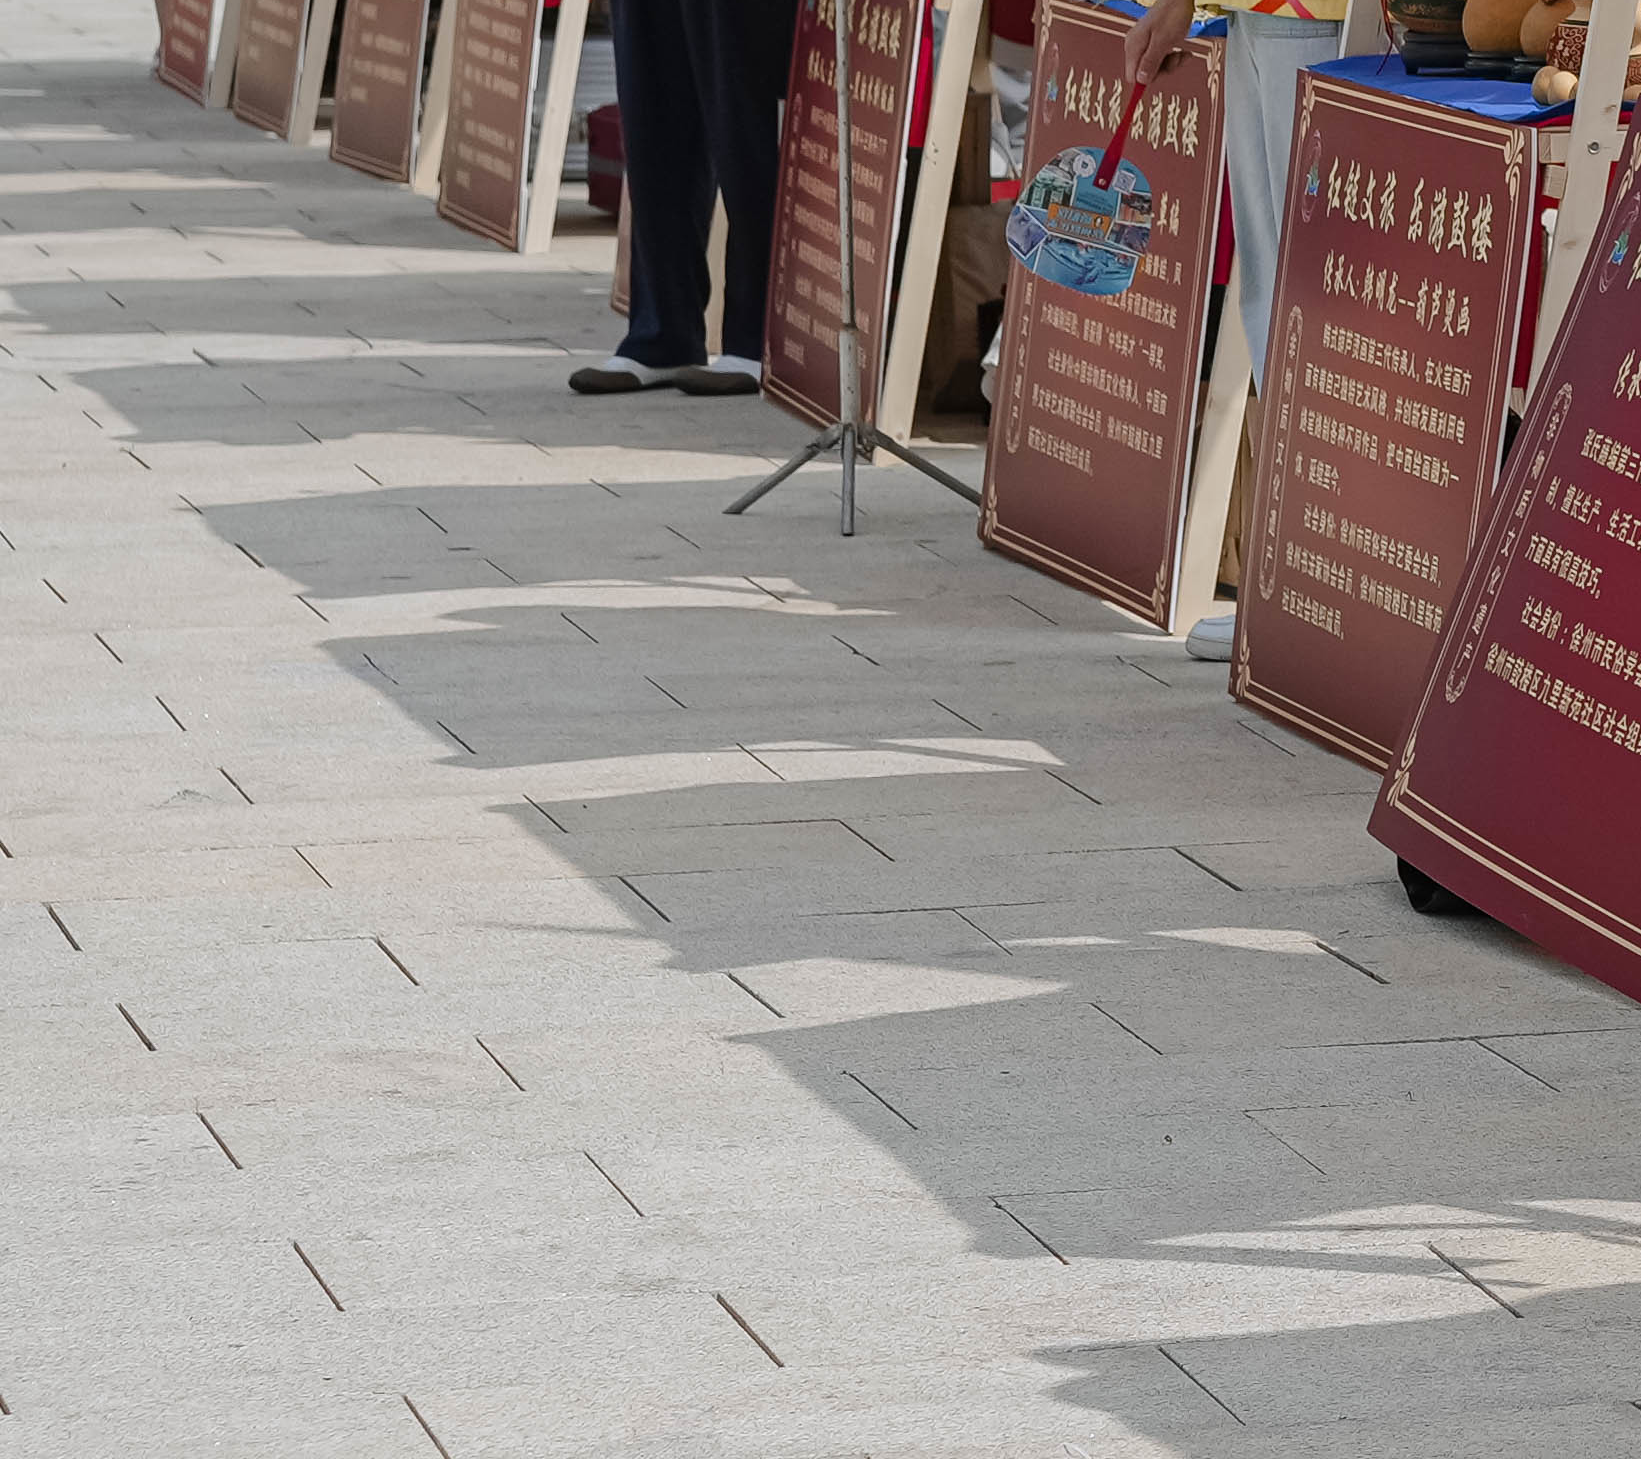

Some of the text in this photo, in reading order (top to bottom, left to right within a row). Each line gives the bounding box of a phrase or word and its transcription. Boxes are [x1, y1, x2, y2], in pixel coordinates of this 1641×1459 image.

[1326, 156, 1493, 264] 红链文旅 乐游鼓楼
